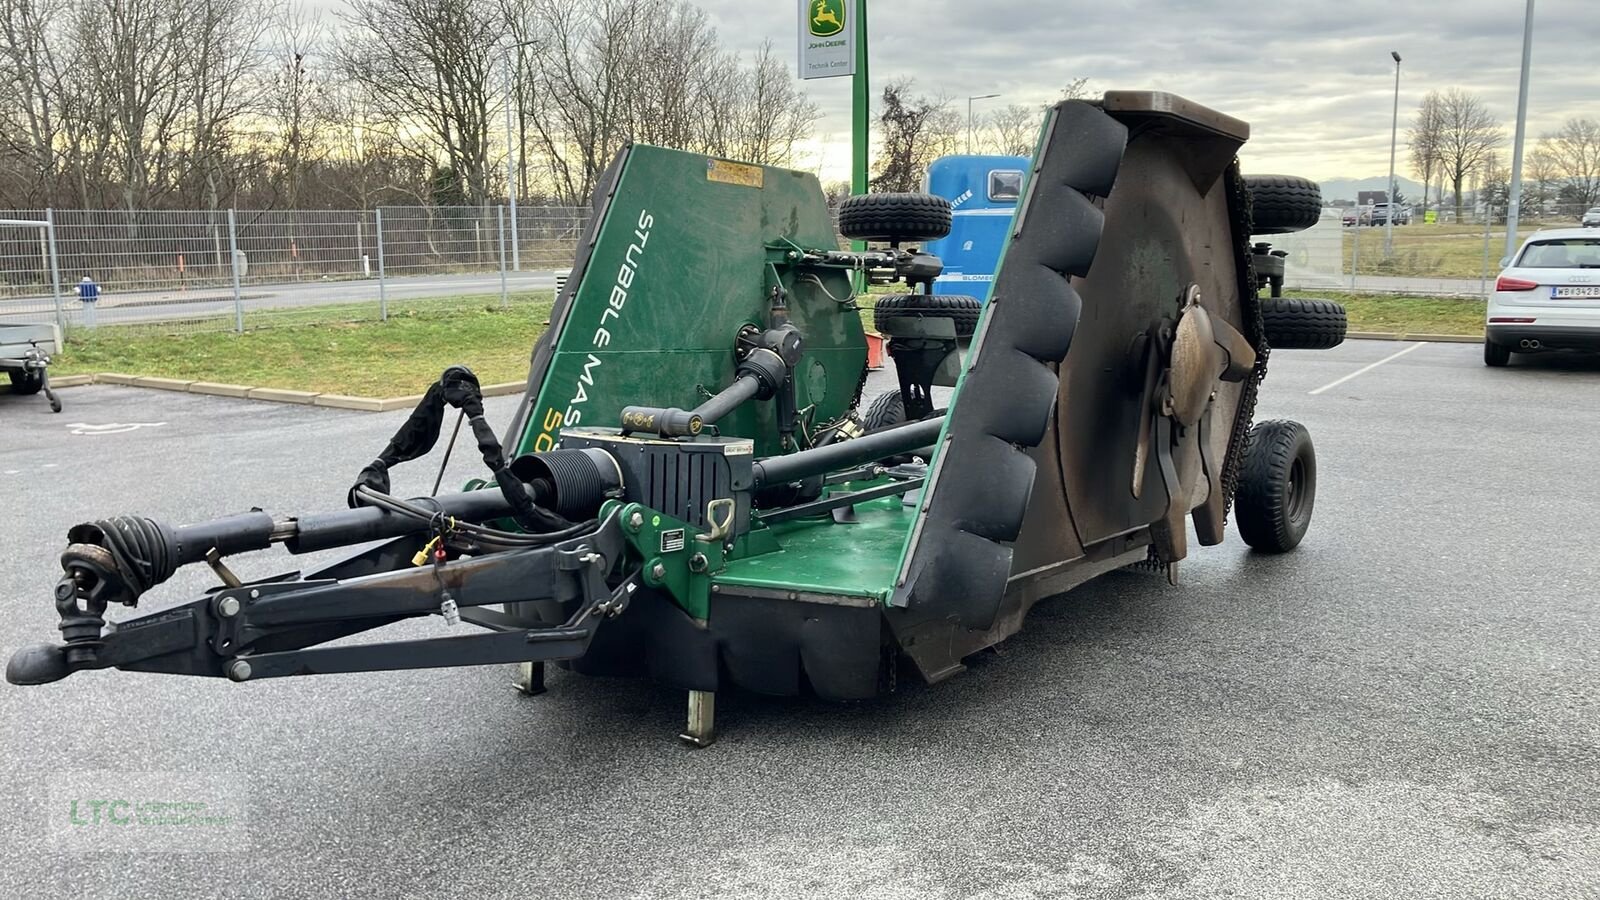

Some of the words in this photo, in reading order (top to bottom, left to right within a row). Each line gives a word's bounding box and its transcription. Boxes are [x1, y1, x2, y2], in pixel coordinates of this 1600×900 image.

[808, 42, 825, 50] JOHN
[825, 40, 847, 48] DEERE
[808, 62, 829, 70] Technik
[830, 60, 848, 68] Center
[592, 208, 655, 348] STUBBLE
[555, 353, 602, 445] MAS
